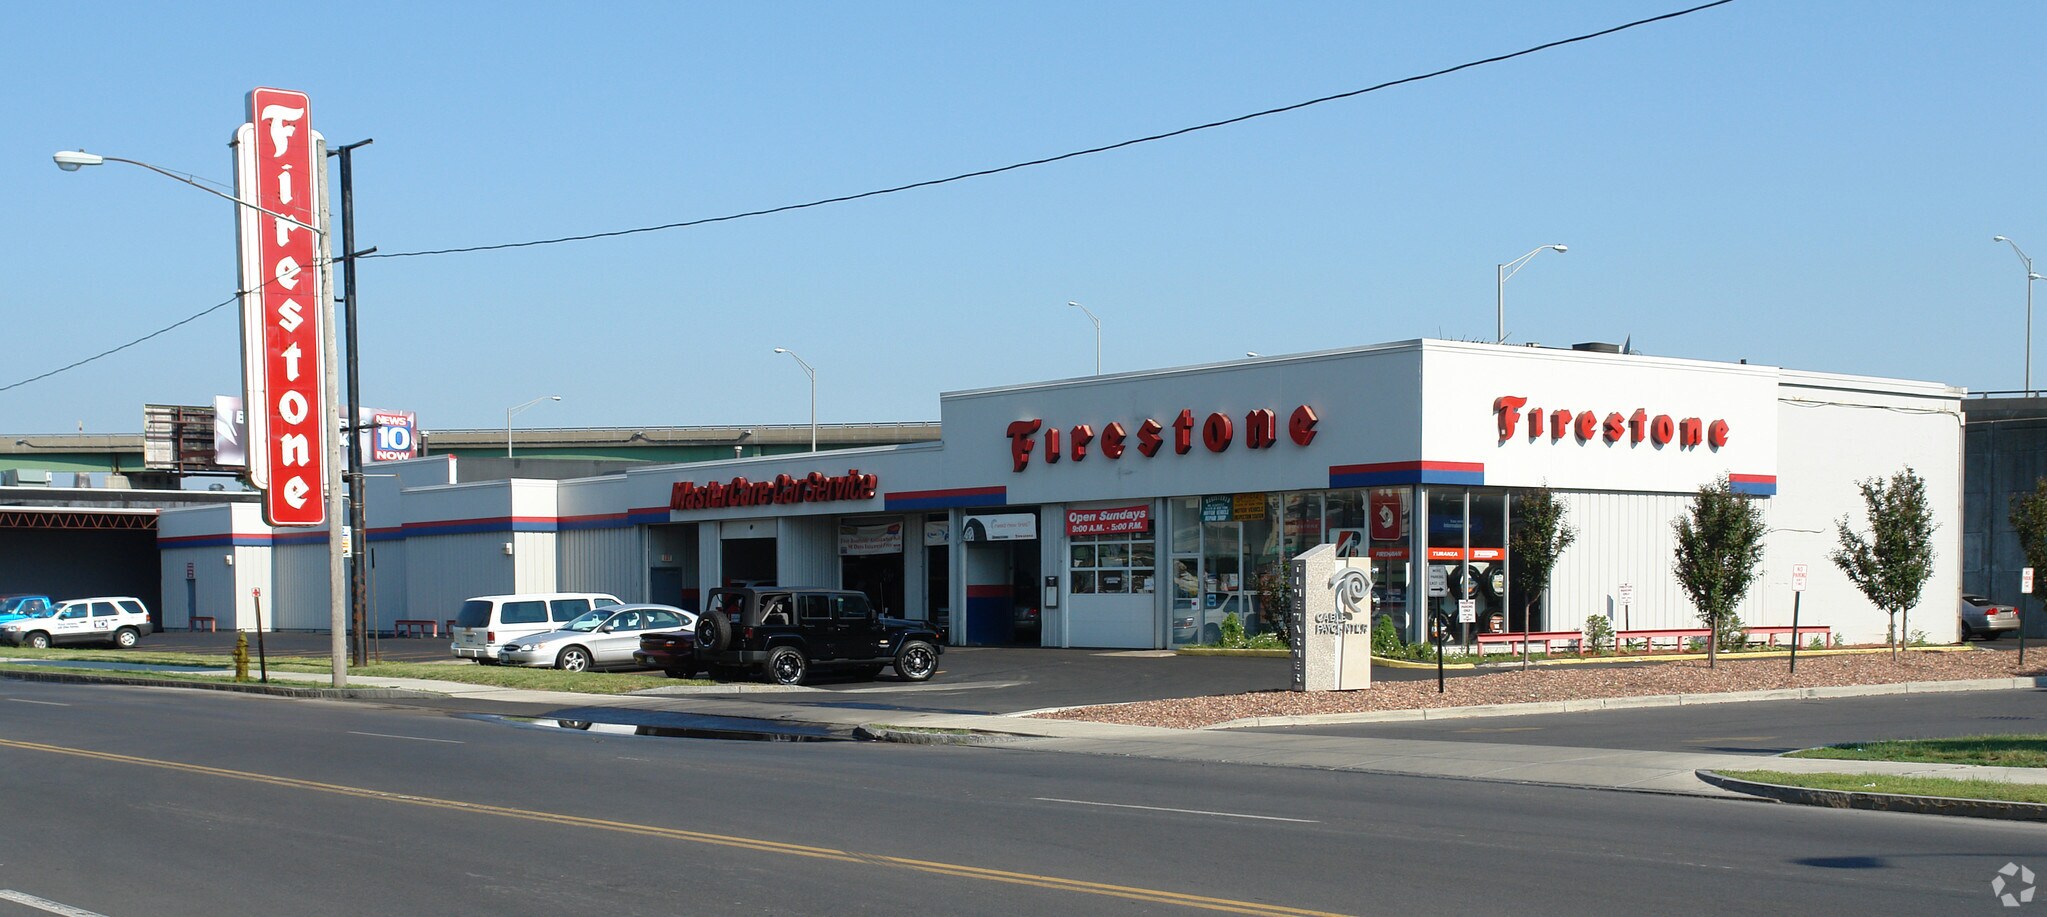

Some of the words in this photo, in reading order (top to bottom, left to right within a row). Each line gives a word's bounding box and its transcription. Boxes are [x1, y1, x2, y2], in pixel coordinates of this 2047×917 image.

[261, 104, 311, 511] Firestone
[375, 414, 408, 426] NEWS
[1492, 395, 1730, 450] Firestone
[377, 426, 411, 450] 10
[1006, 404, 1319, 473] Firestone
[376, 450, 411, 461] NOW
[1069, 512, 1097, 524] Open
[1099, 509, 1146, 521] Sundays
[1072, 524, 1088, 533] 9:00
[1088, 524, 1105, 532] A.M.
[1111, 523, 1127, 531] 5:00
[1128, 522, 1143, 530] P.M.
[1314, 612, 1347, 624] CABLE
